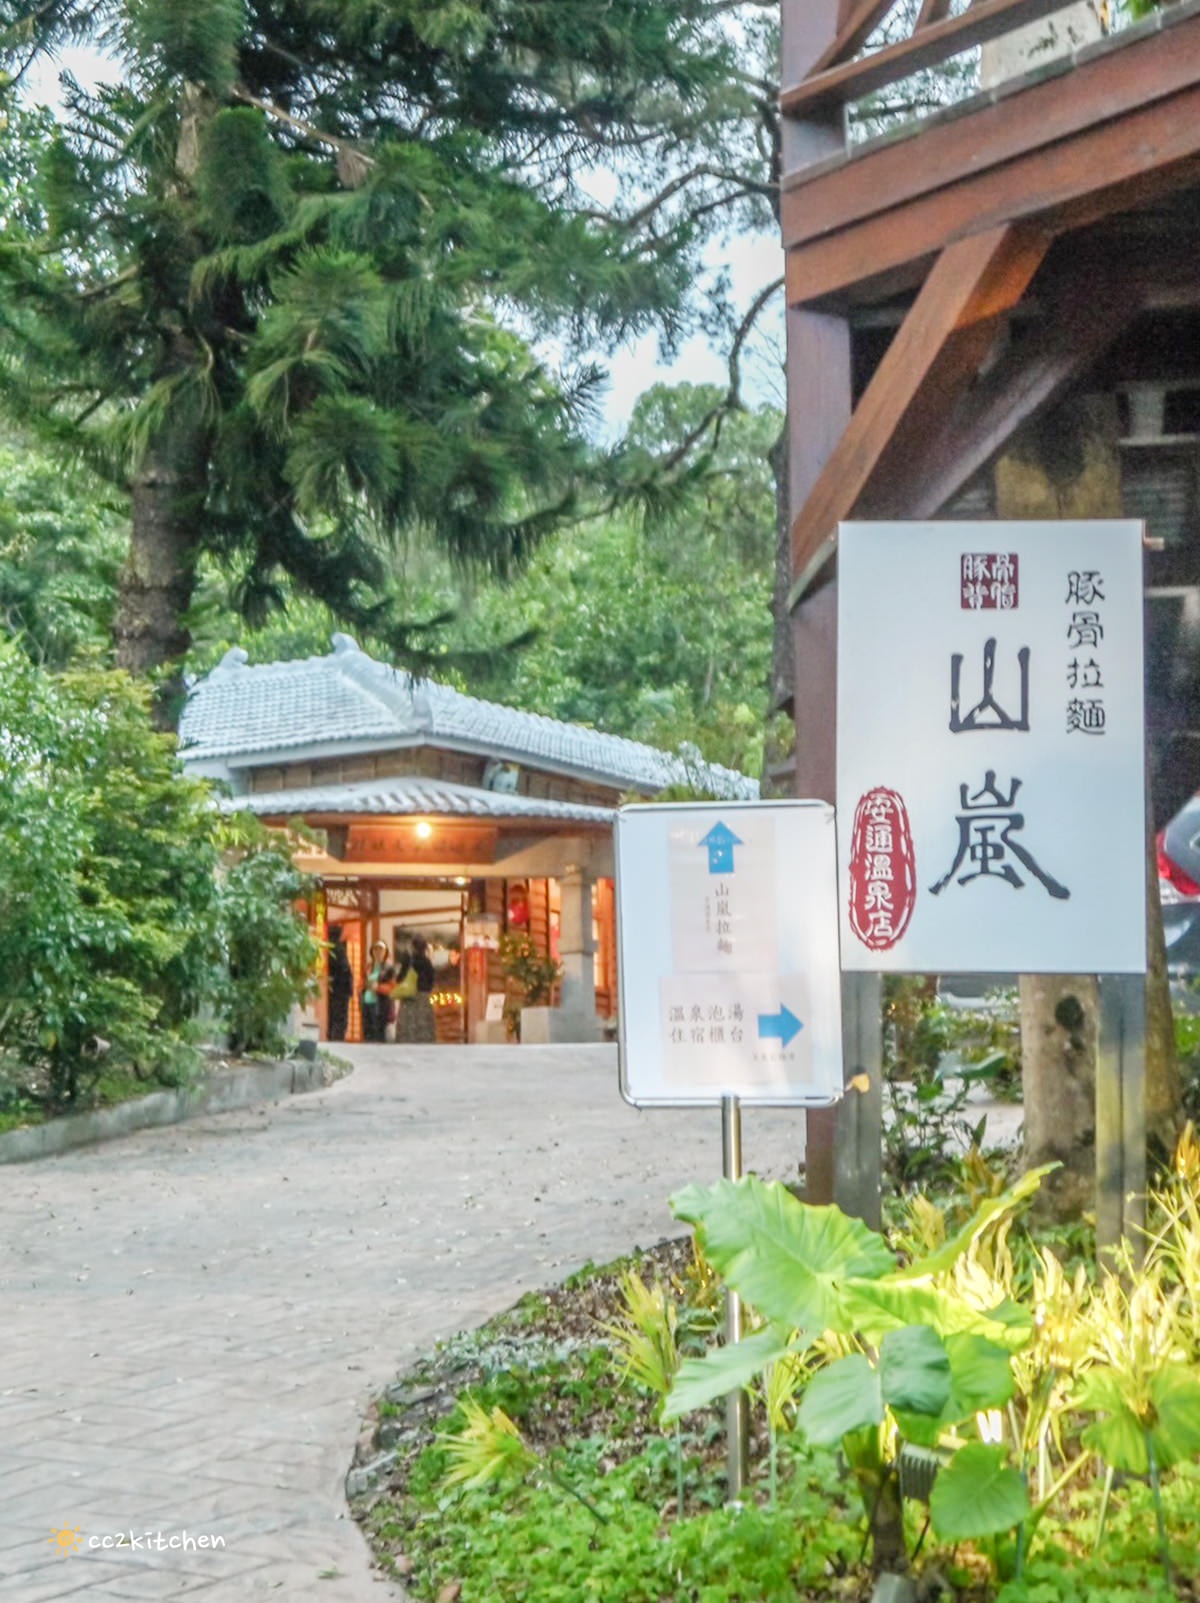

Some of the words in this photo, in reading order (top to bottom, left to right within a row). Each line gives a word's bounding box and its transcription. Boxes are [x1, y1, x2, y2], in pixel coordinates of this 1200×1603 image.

[1065, 571, 1106, 736] 豚骨拉麵
[928, 637, 1070, 900] 山嵐
